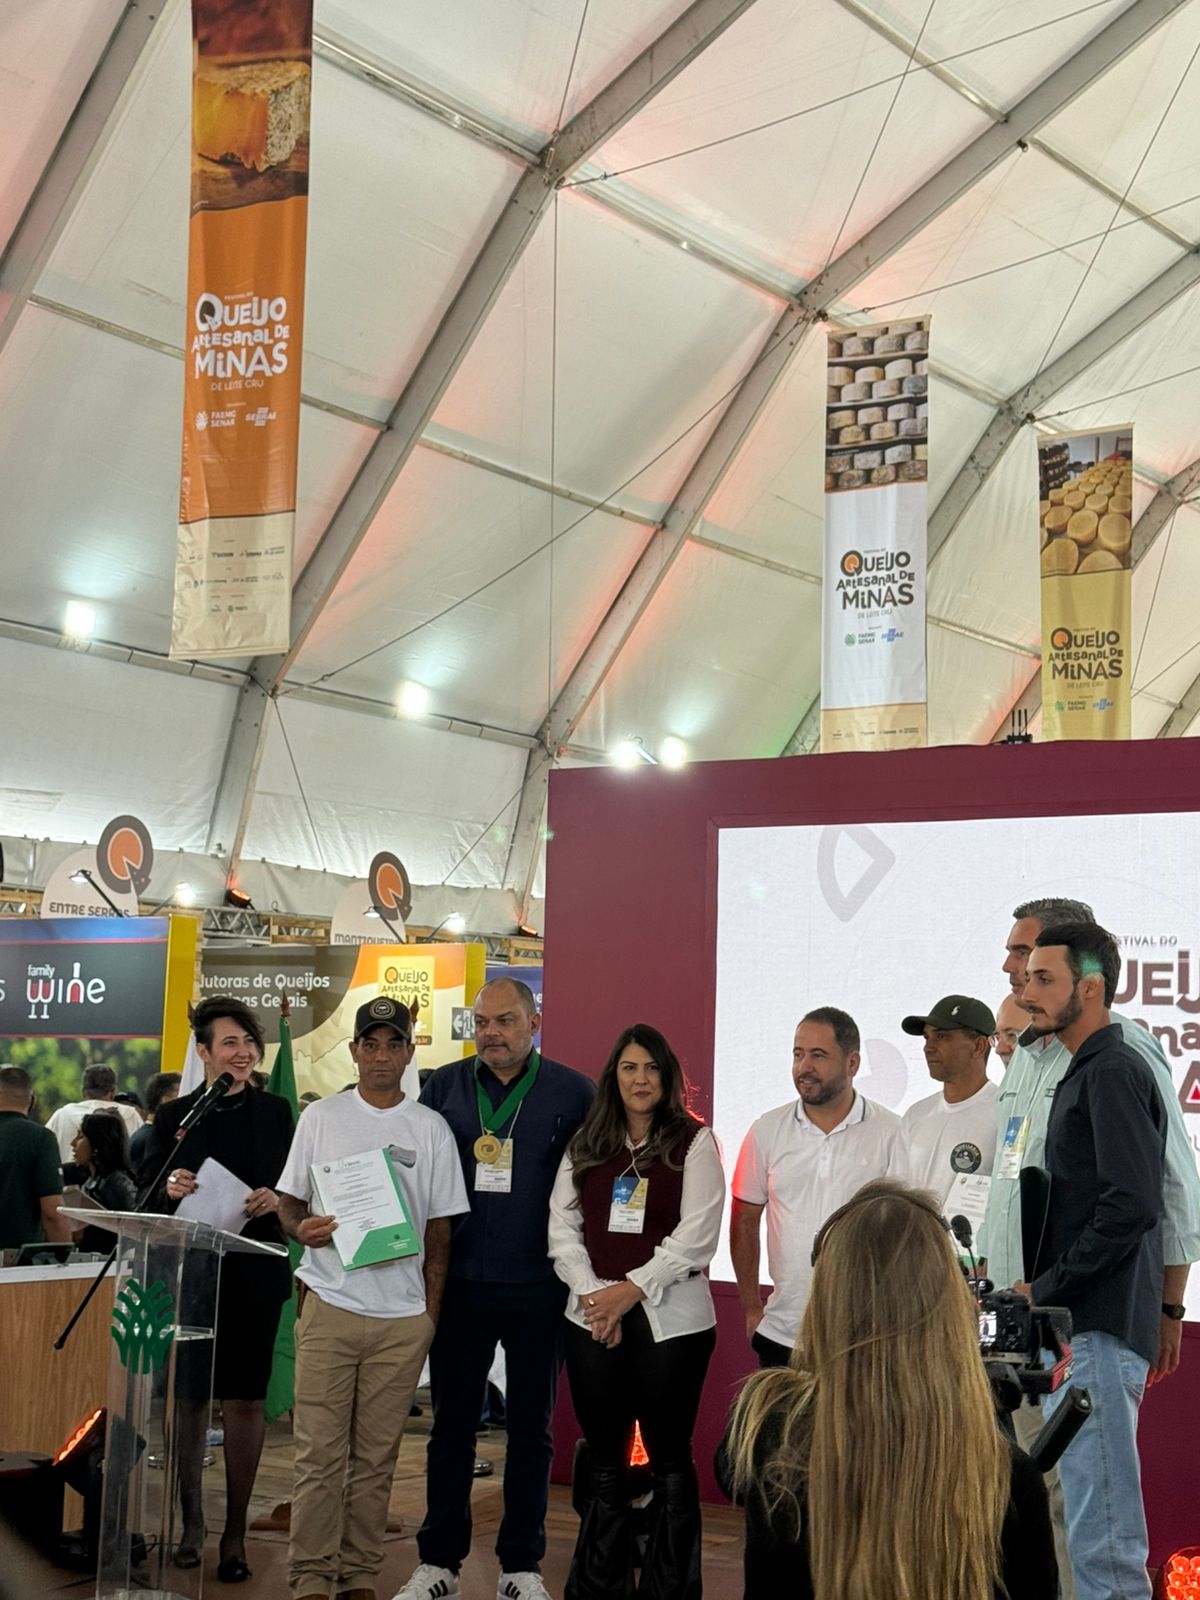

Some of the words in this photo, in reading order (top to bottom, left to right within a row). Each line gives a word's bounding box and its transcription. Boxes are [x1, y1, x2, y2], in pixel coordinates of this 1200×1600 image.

[274, 324, 290, 340] DE
[899, 570, 915, 581] DE
[49, 902, 86, 915] ENTRE
[1160, 935, 1178, 946] DO
[27, 964, 56, 979] family
[253, 973, 271, 988] de
[275, 972, 331, 991] Queijos
[261, 992, 308, 1007] Geais
